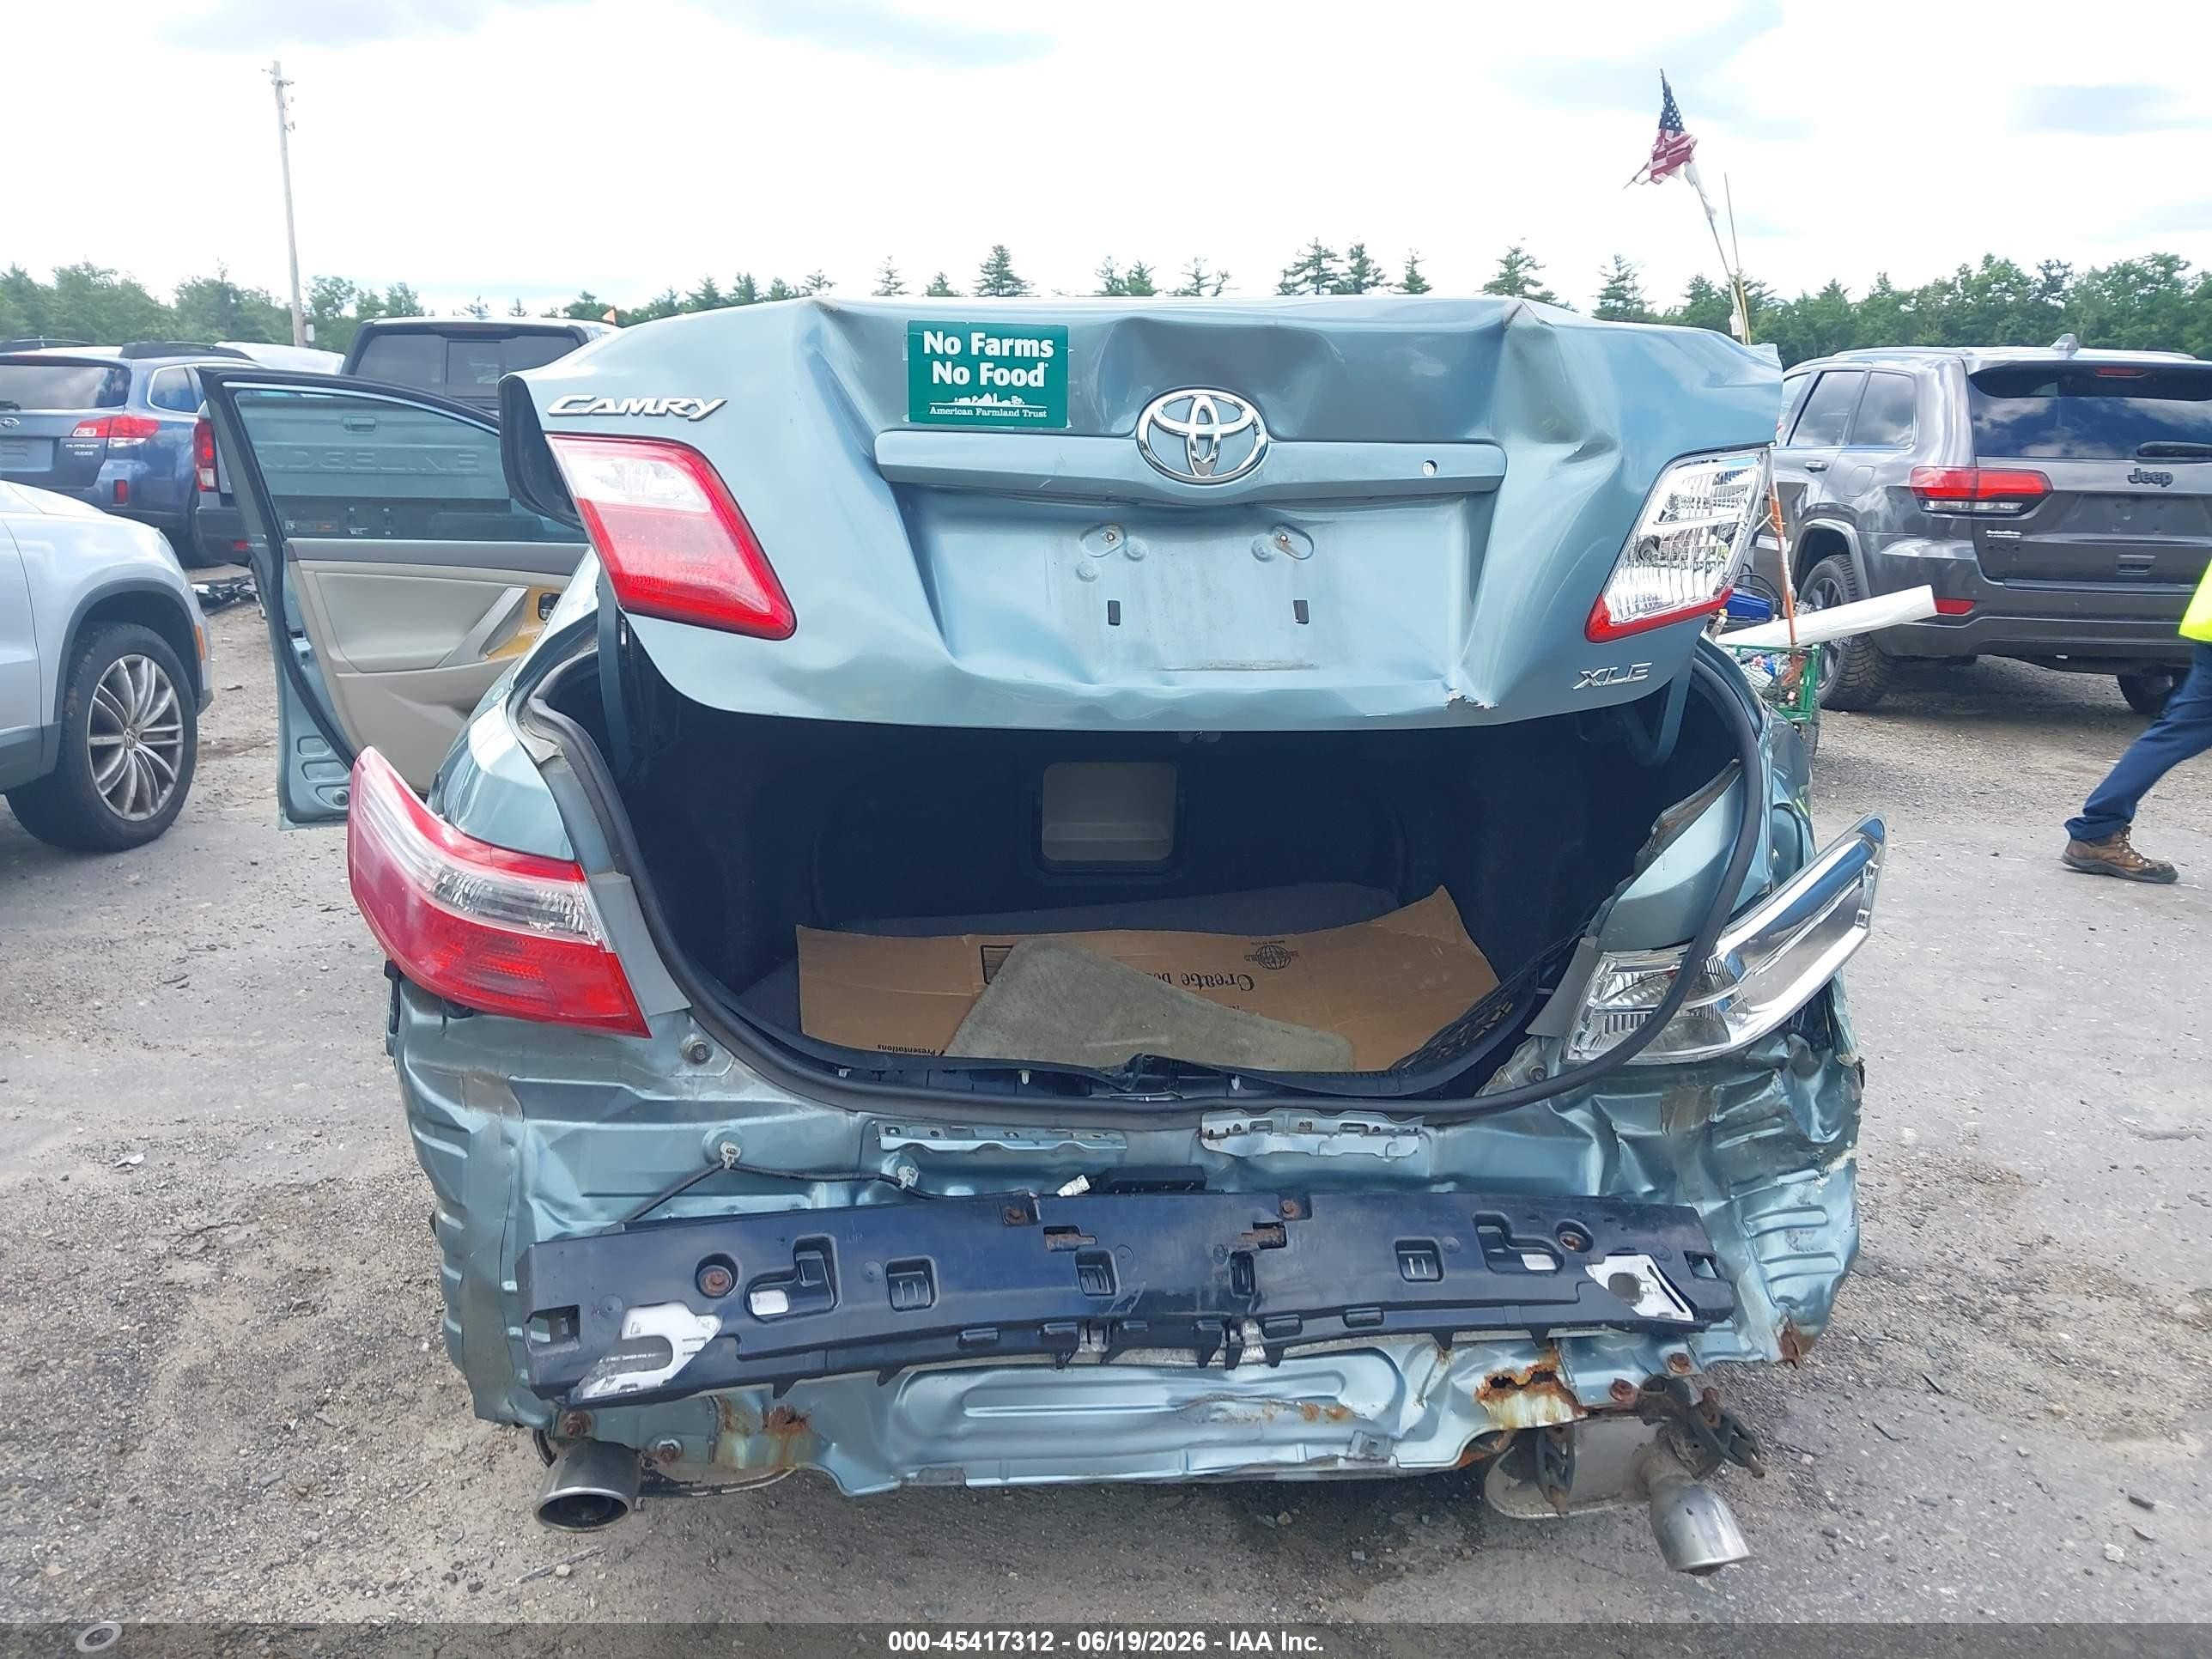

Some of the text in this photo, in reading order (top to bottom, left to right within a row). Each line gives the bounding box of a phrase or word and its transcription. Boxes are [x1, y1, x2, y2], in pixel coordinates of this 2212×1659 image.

[923, 330, 1054, 358] No Farms
[932, 361, 1045, 387] No Food
[547, 394, 728, 422] CAMRY
[929, 405, 1048, 418] American Farmland Trust
[2127, 467, 2173, 489] Jeep
[1571, 661, 1653, 690] XLE
[1181, 972, 1255, 993] Create
[877, 1043, 936, 1056] Presentations
